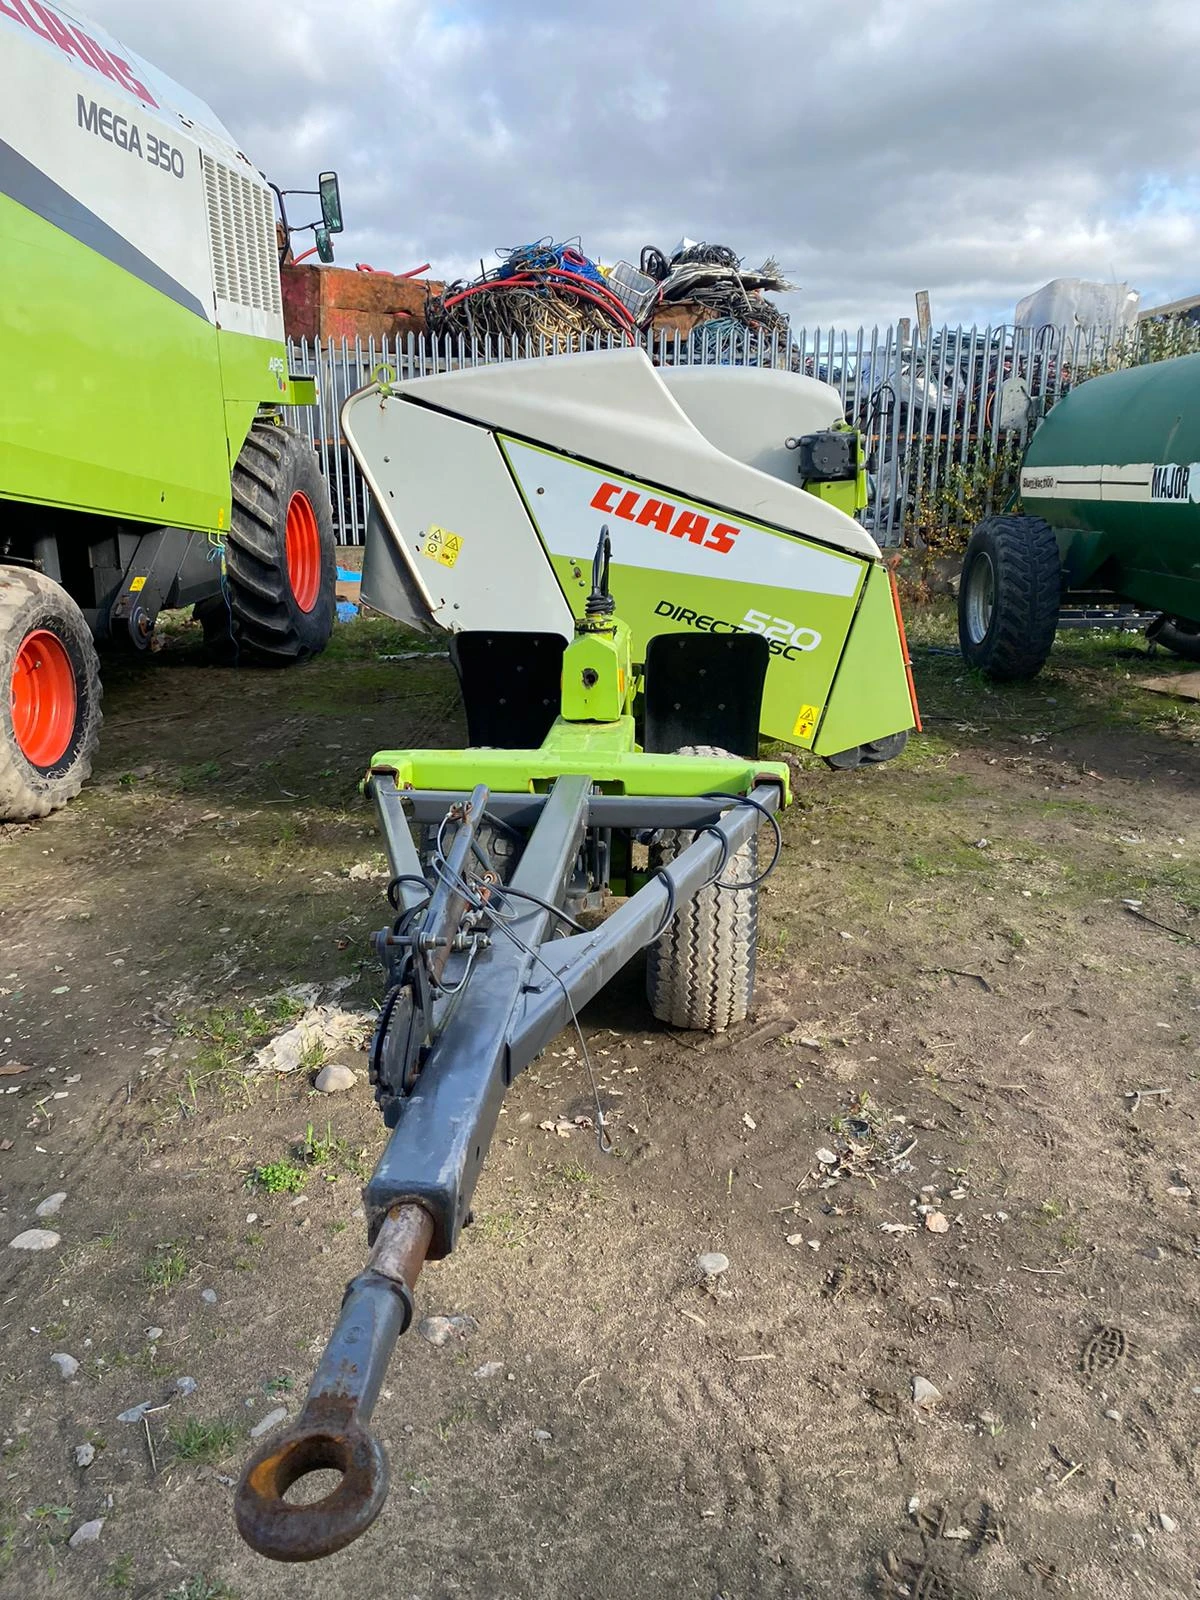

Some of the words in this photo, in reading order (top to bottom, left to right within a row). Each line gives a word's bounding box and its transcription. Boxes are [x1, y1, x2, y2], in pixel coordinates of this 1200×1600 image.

[77, 93, 143, 159] MEGA
[146, 132, 184, 179] 350
[268, 356, 284, 373] APS
[1151, 466, 1190, 499] MAJOR
[590, 482, 741, 554] CLAAS
[738, 608, 822, 652] 520
